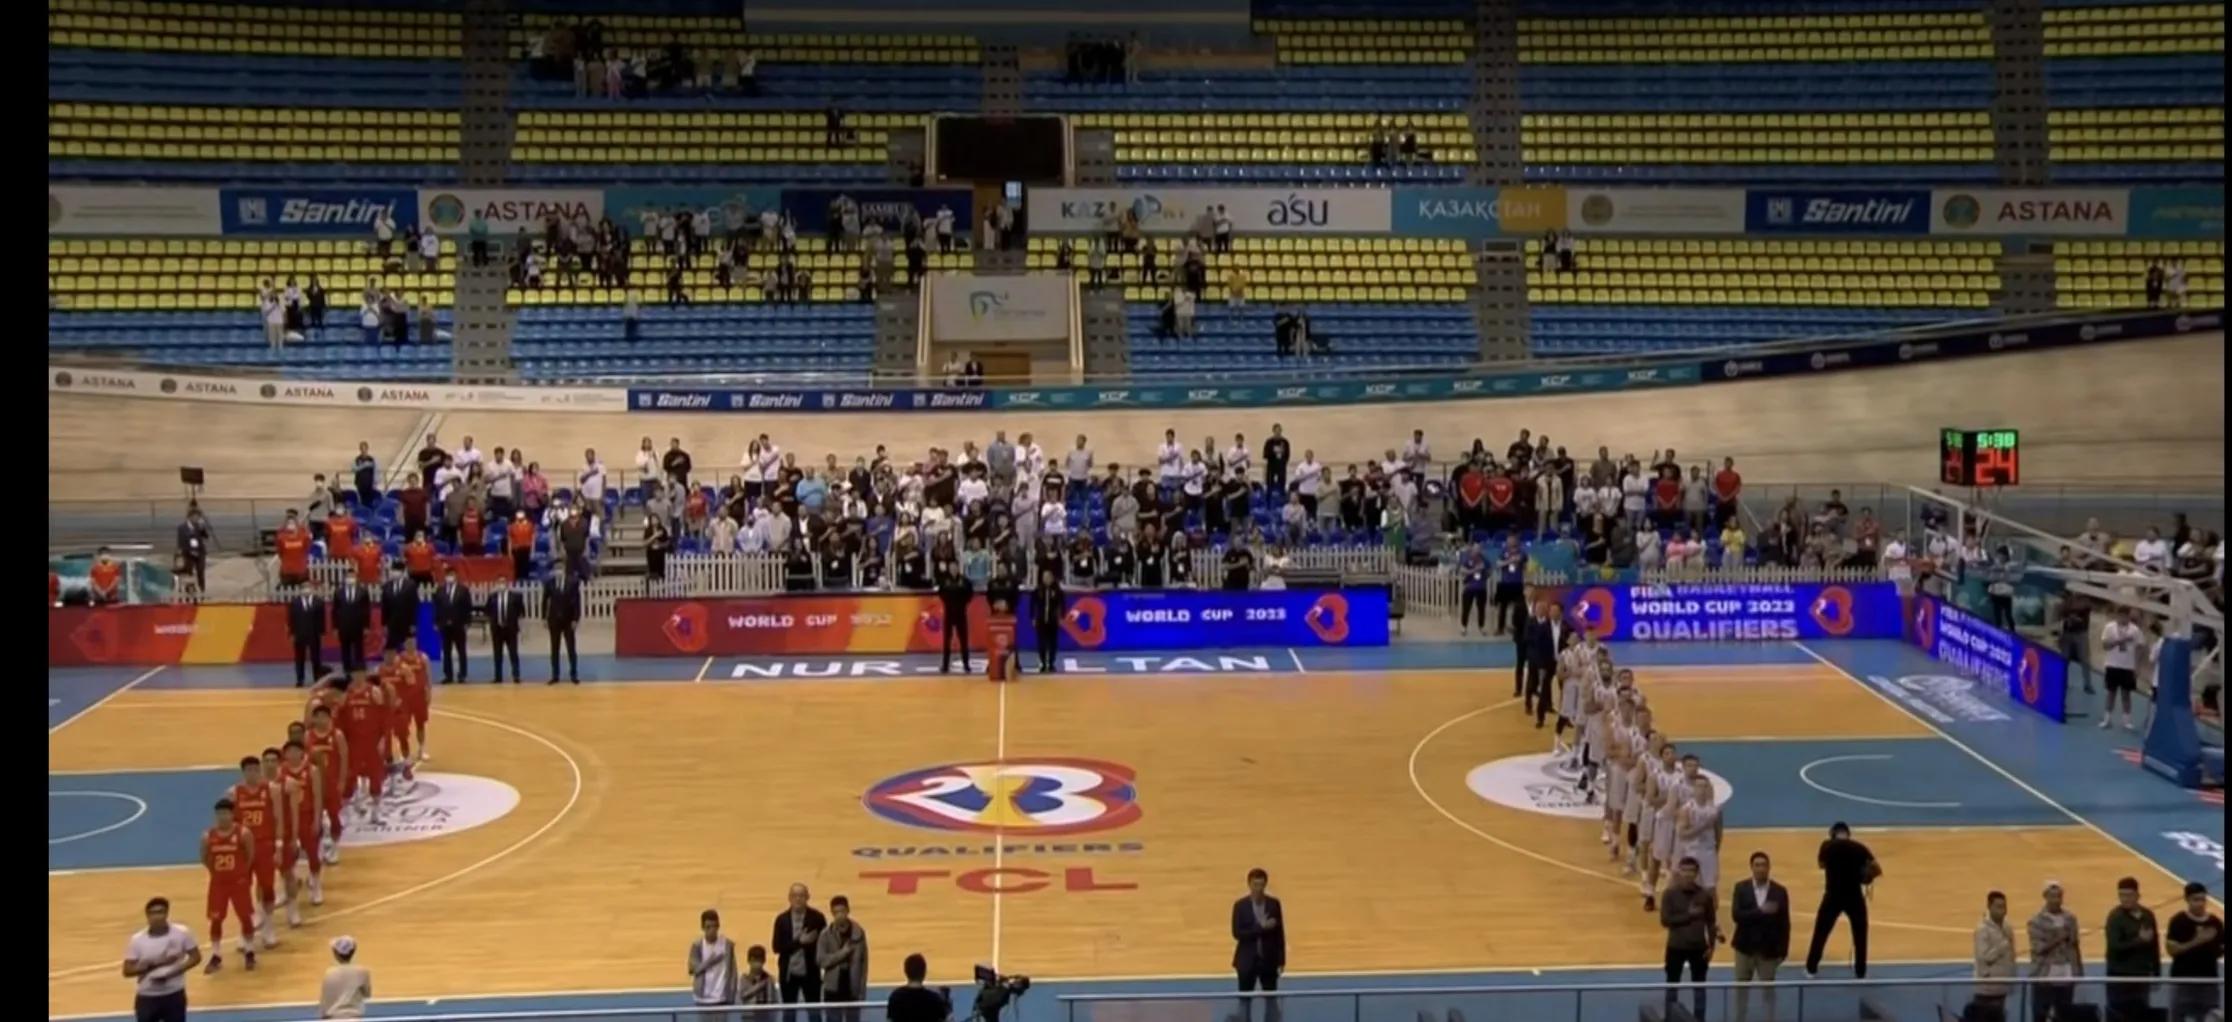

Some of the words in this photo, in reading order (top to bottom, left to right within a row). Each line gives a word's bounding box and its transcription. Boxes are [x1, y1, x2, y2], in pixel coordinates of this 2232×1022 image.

[485, 201, 591, 221] ASTANA
[1802, 199, 1913, 224] Santini
[1998, 200, 2112, 221] ASTANA
[81, 376, 136, 390] ASTANA
[185, 382, 236, 395] ASTANA
[284, 387, 334, 399] ASTANA
[380, 390, 429, 401] ASTANA
[1976, 448, 2015, 483] 24
[1125, 609, 1191, 623] WORLD
[1202, 608, 1233, 621] CUP
[1631, 601, 1700, 615] WORLD
[1705, 600, 1741, 614] CUP
[728, 614, 795, 628] WORLD
[805, 614, 838, 627] CUP
[1633, 620, 1798, 639] QUALIFIERS
[853, 843, 1144, 859] QUALIFIERS
[214, 855, 235, 871] 29
[859, 867, 1139, 895] TCL
